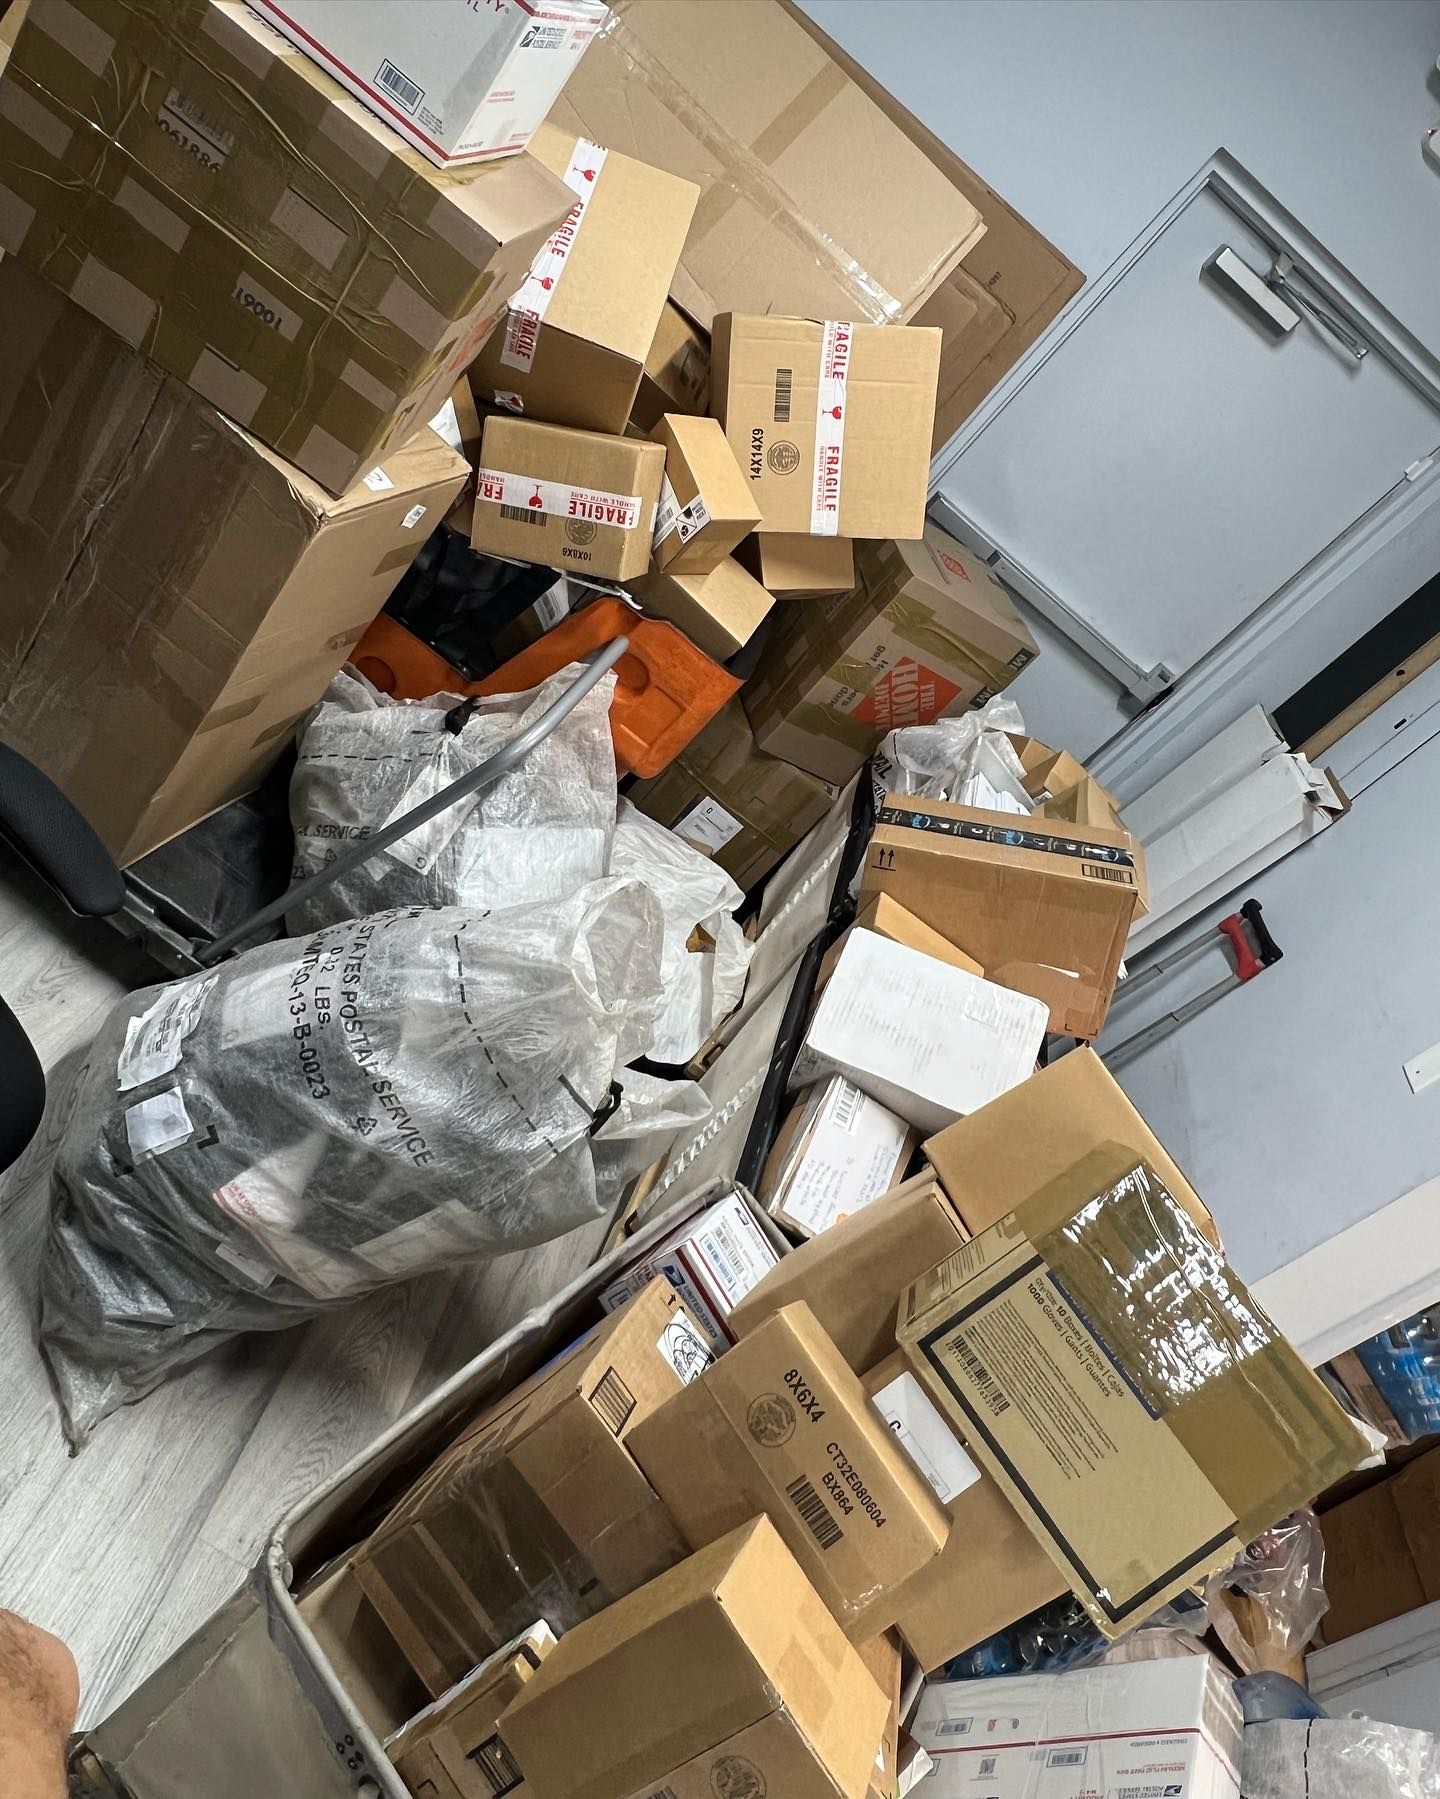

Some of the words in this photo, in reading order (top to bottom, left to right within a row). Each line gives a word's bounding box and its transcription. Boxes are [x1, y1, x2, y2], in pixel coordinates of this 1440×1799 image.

[750, 428, 764, 480] 14X14X9
[824, 446, 840, 512] FRAGILE
[568, 500, 635, 526] FRAGILE
[313, 824, 371, 840] SERVICE
[372, 1080, 435, 1168] SERVICE
[784, 1368, 827, 1423] 8X6X4
[821, 1471, 854, 1516] BX864
[826, 1442, 887, 1528] CT32E080604
